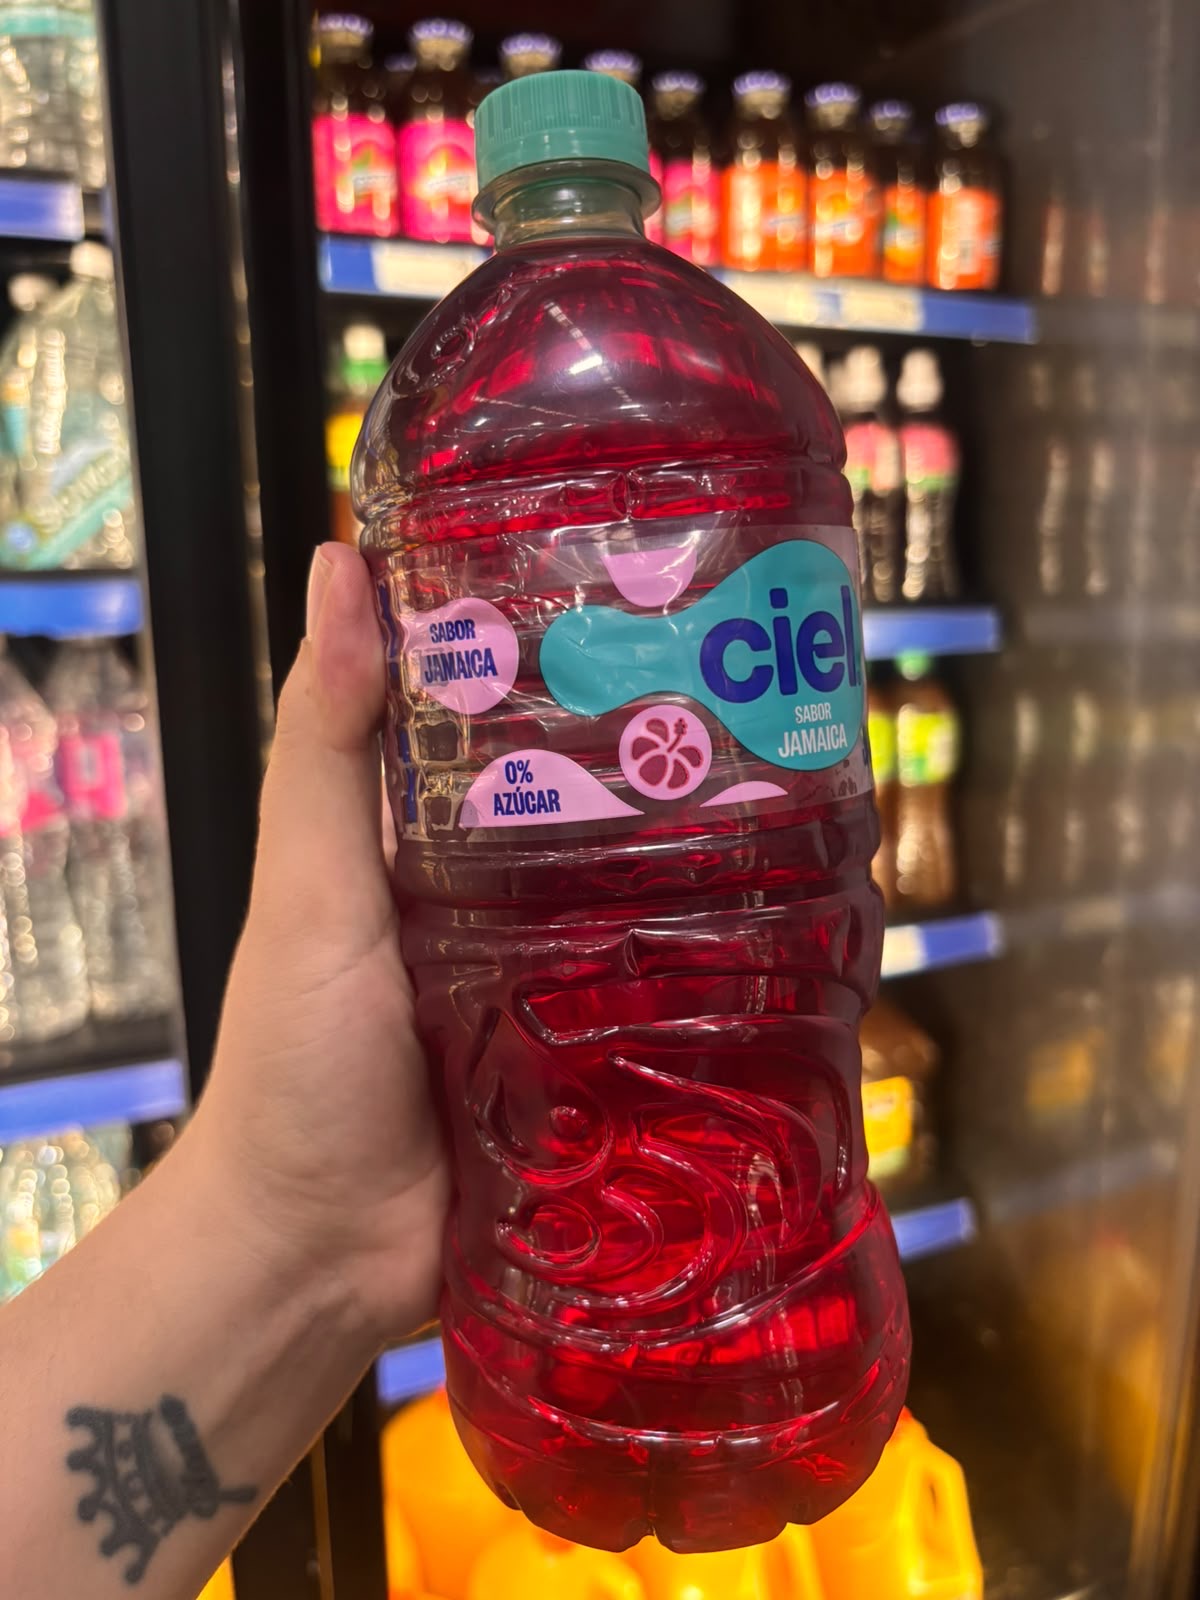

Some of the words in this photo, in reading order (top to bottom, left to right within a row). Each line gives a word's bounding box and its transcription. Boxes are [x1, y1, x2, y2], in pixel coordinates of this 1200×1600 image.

[429, 618, 477, 645] SABOR
[700, 585, 857, 703] ciel
[424, 648, 499, 684] JAMAICA
[795, 702, 832, 724] SABOR
[778, 723, 848, 759] JAMAICA
[505, 759, 533, 785] 0%
[494, 787, 561, 816] AZÚCAR
